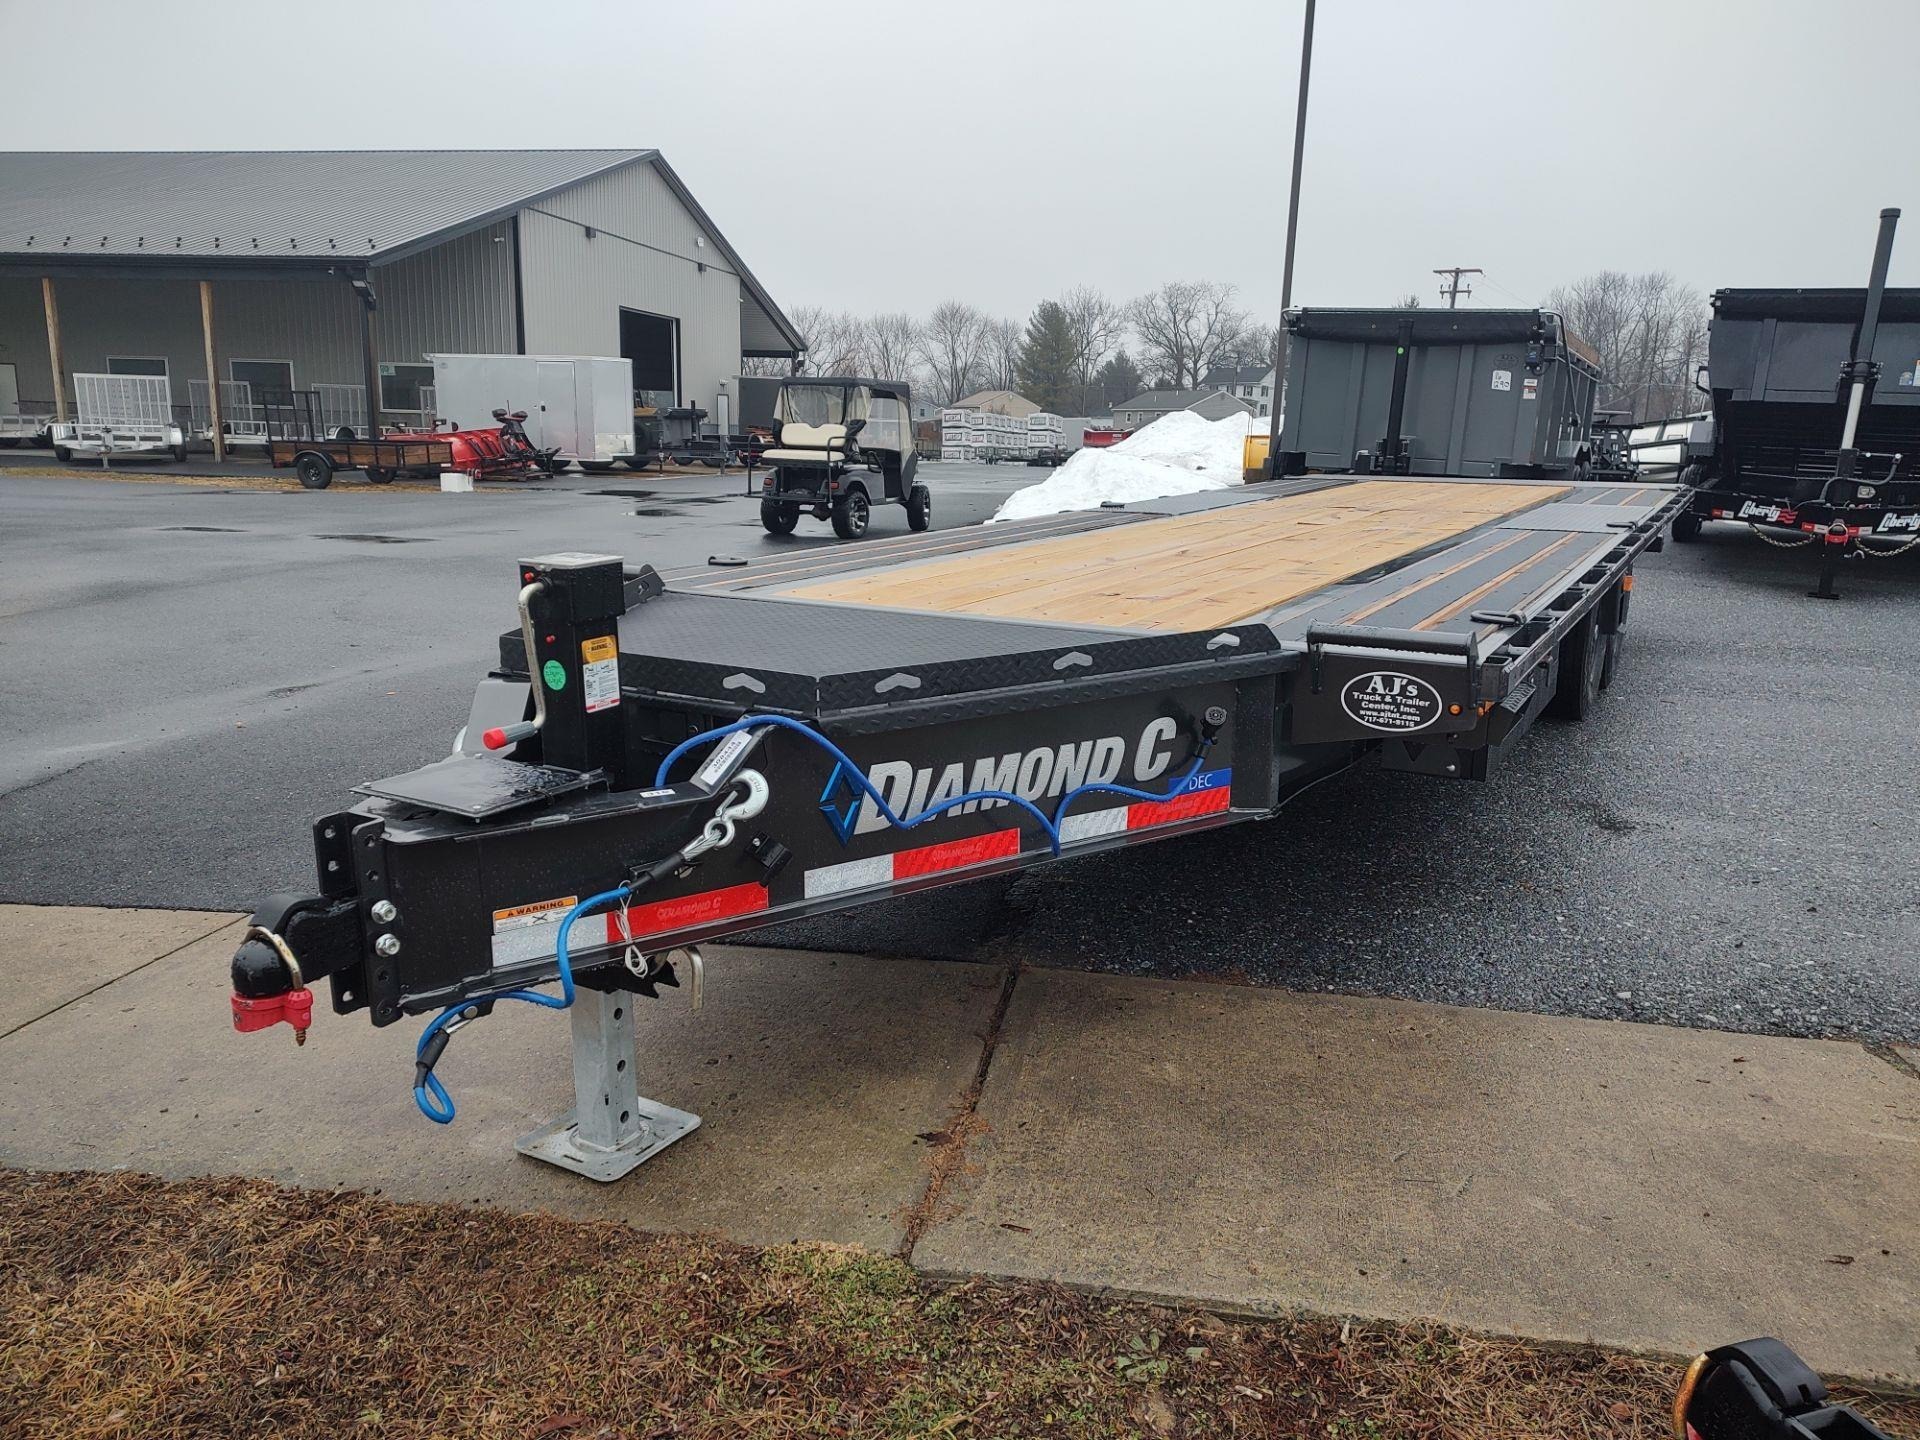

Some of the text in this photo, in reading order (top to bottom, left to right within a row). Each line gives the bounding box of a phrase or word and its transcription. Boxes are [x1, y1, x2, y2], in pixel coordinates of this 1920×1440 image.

[1738, 501, 1782, 521] Liberty
[1365, 675, 1418, 696] AJ's
[1352, 692, 1430, 707] Truck & Trailer
[1361, 702, 1420, 714] Center, Inc.
[853, 716, 1177, 835] DIAMOND C
[1188, 773, 1213, 790] DEC
[516, 900, 564, 915] WARNING
